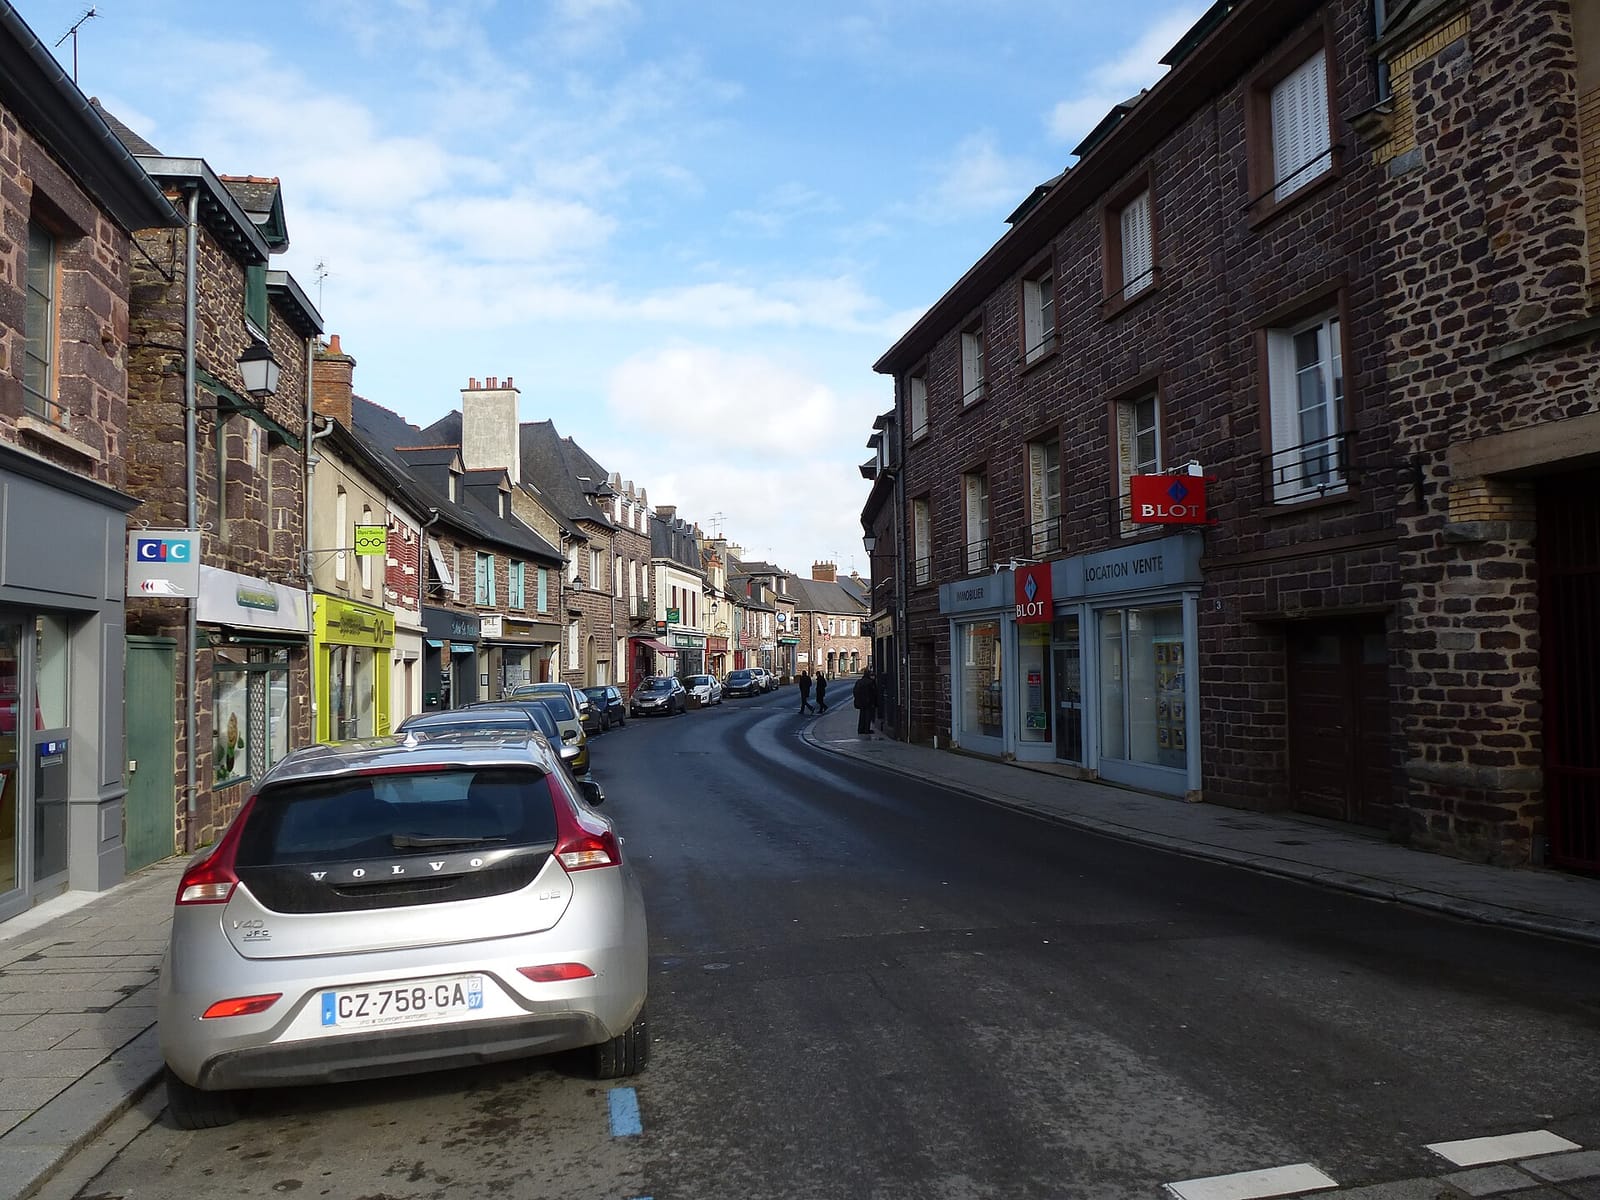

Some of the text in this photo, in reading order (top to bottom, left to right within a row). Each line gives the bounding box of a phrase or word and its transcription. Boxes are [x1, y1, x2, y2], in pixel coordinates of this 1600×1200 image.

[1141, 504, 1200, 517] BLOT
[142, 543, 185, 559] CIC
[1085, 555, 1163, 582] LOCATION VENTE
[956, 587, 984, 601] IMMOBILIER
[1015, 601, 1044, 618] BLOT
[1215, 600, 1223, 611] 3
[310, 858, 483, 881] VOLVO
[232, 919, 265, 929] V40
[339, 983, 465, 1019] CZ-758-GA
[469, 994, 482, 1007] 37
[325, 1011, 332, 1020] F
